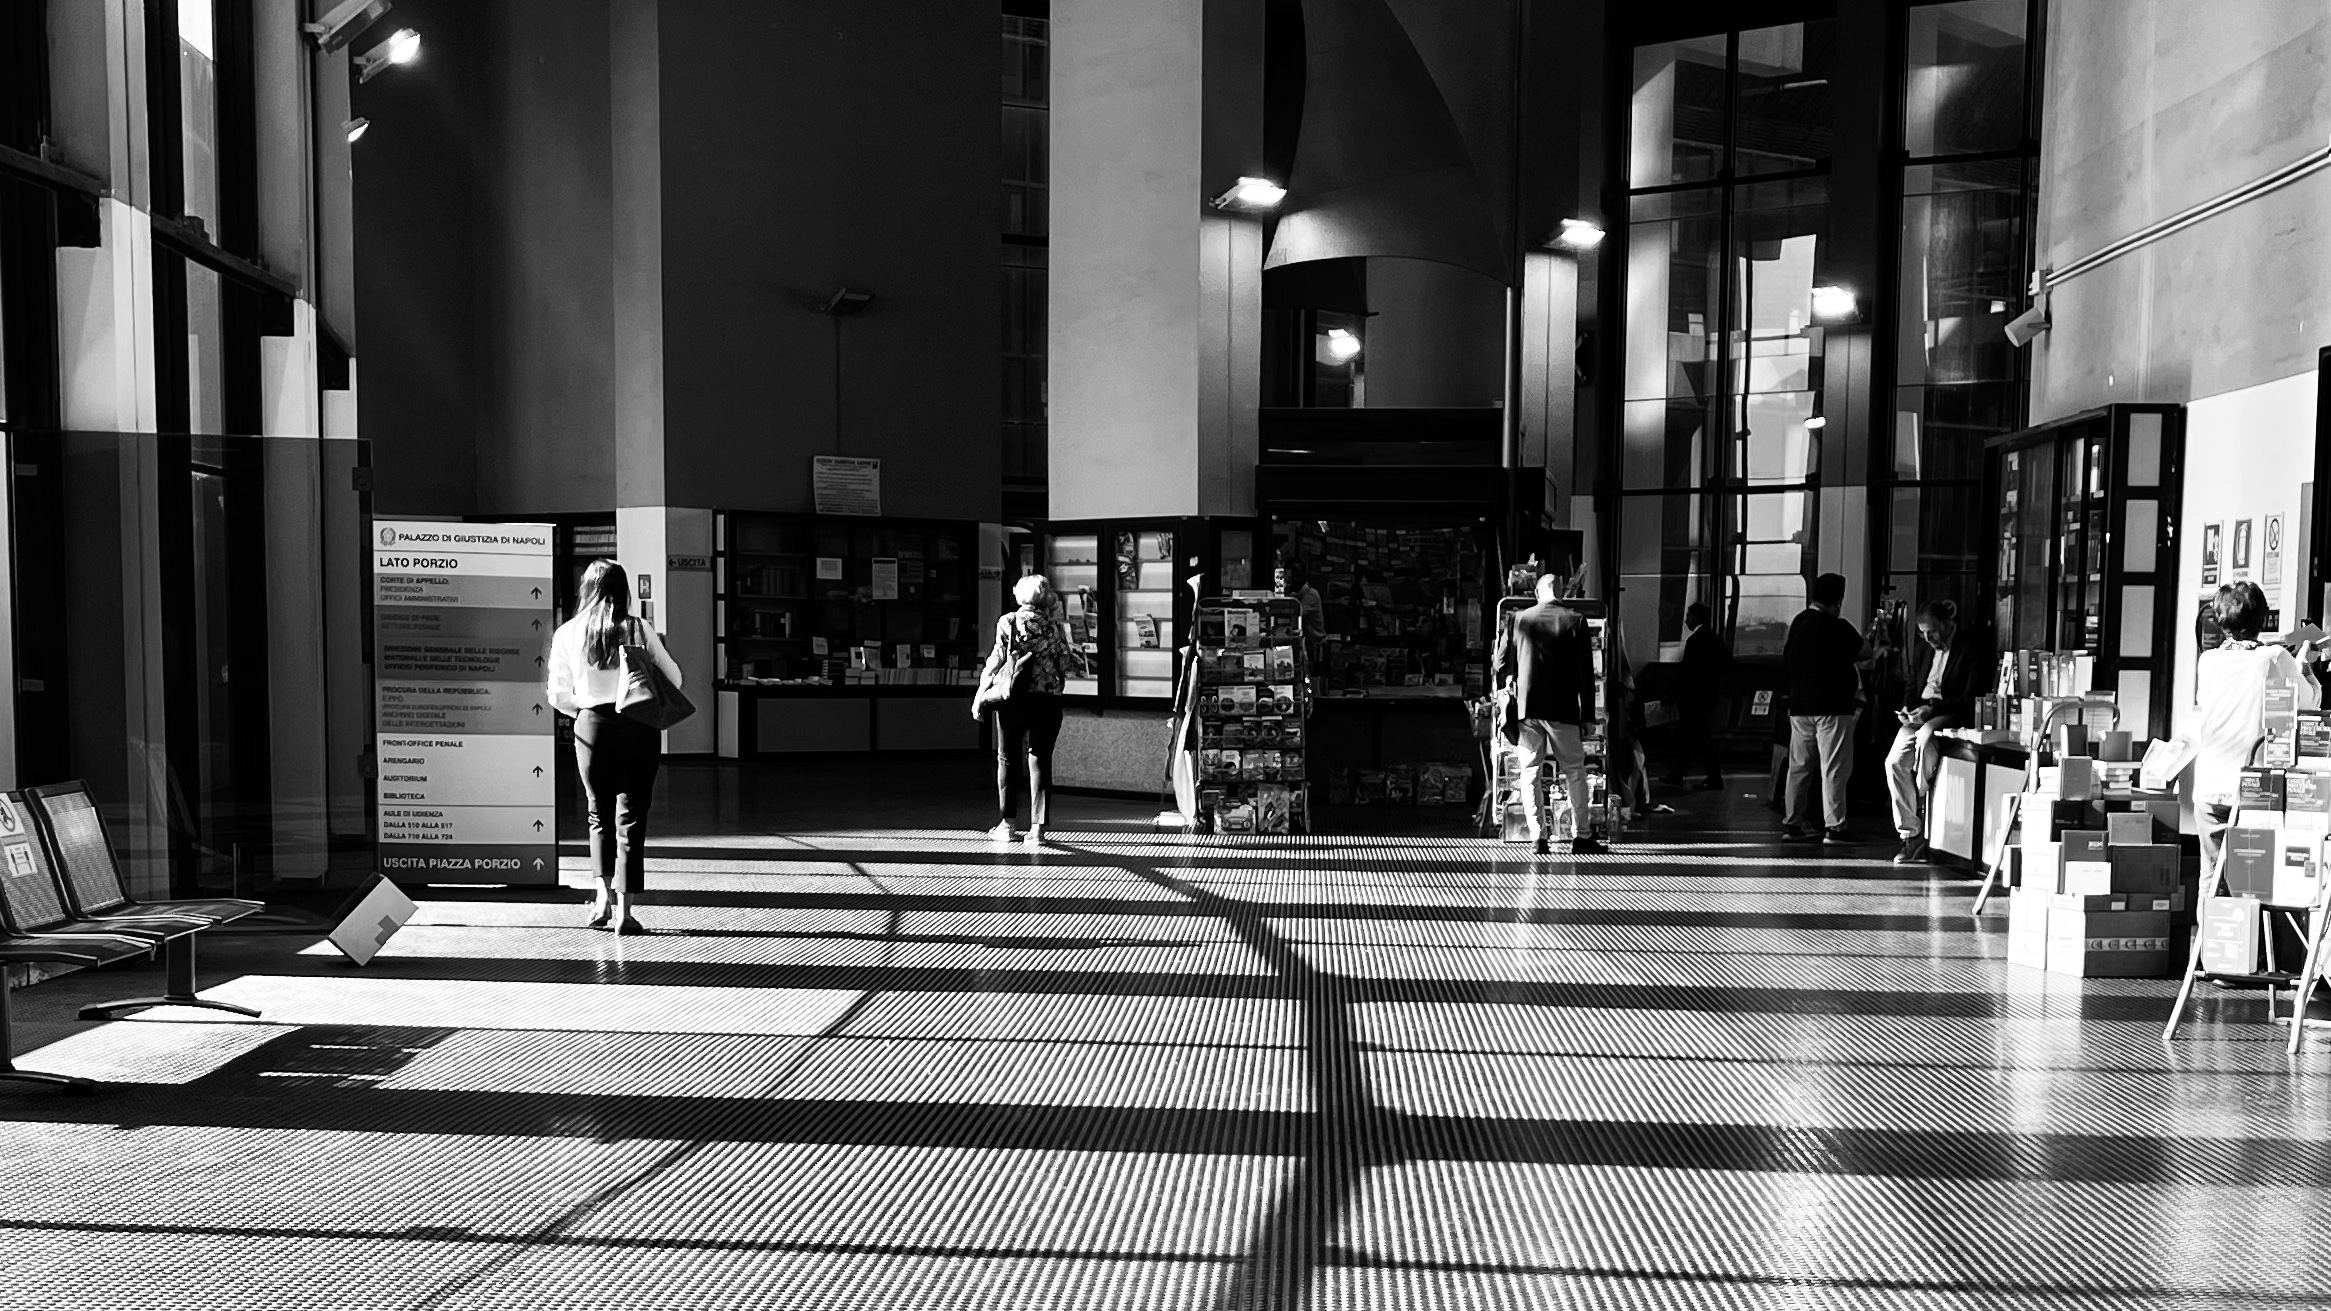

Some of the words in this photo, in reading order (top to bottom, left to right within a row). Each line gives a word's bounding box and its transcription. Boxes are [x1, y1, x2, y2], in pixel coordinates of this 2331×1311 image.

[454, 535, 498, 543] GIUSTIZIA
[380, 558, 409, 567] LATO
[414, 559, 458, 568] PORZIO
[678, 558, 706, 566] USCITA
[383, 858, 426, 868] USCITA
[429, 858, 471, 869] PIAZZA
[475, 858, 520, 869] PORZIO
